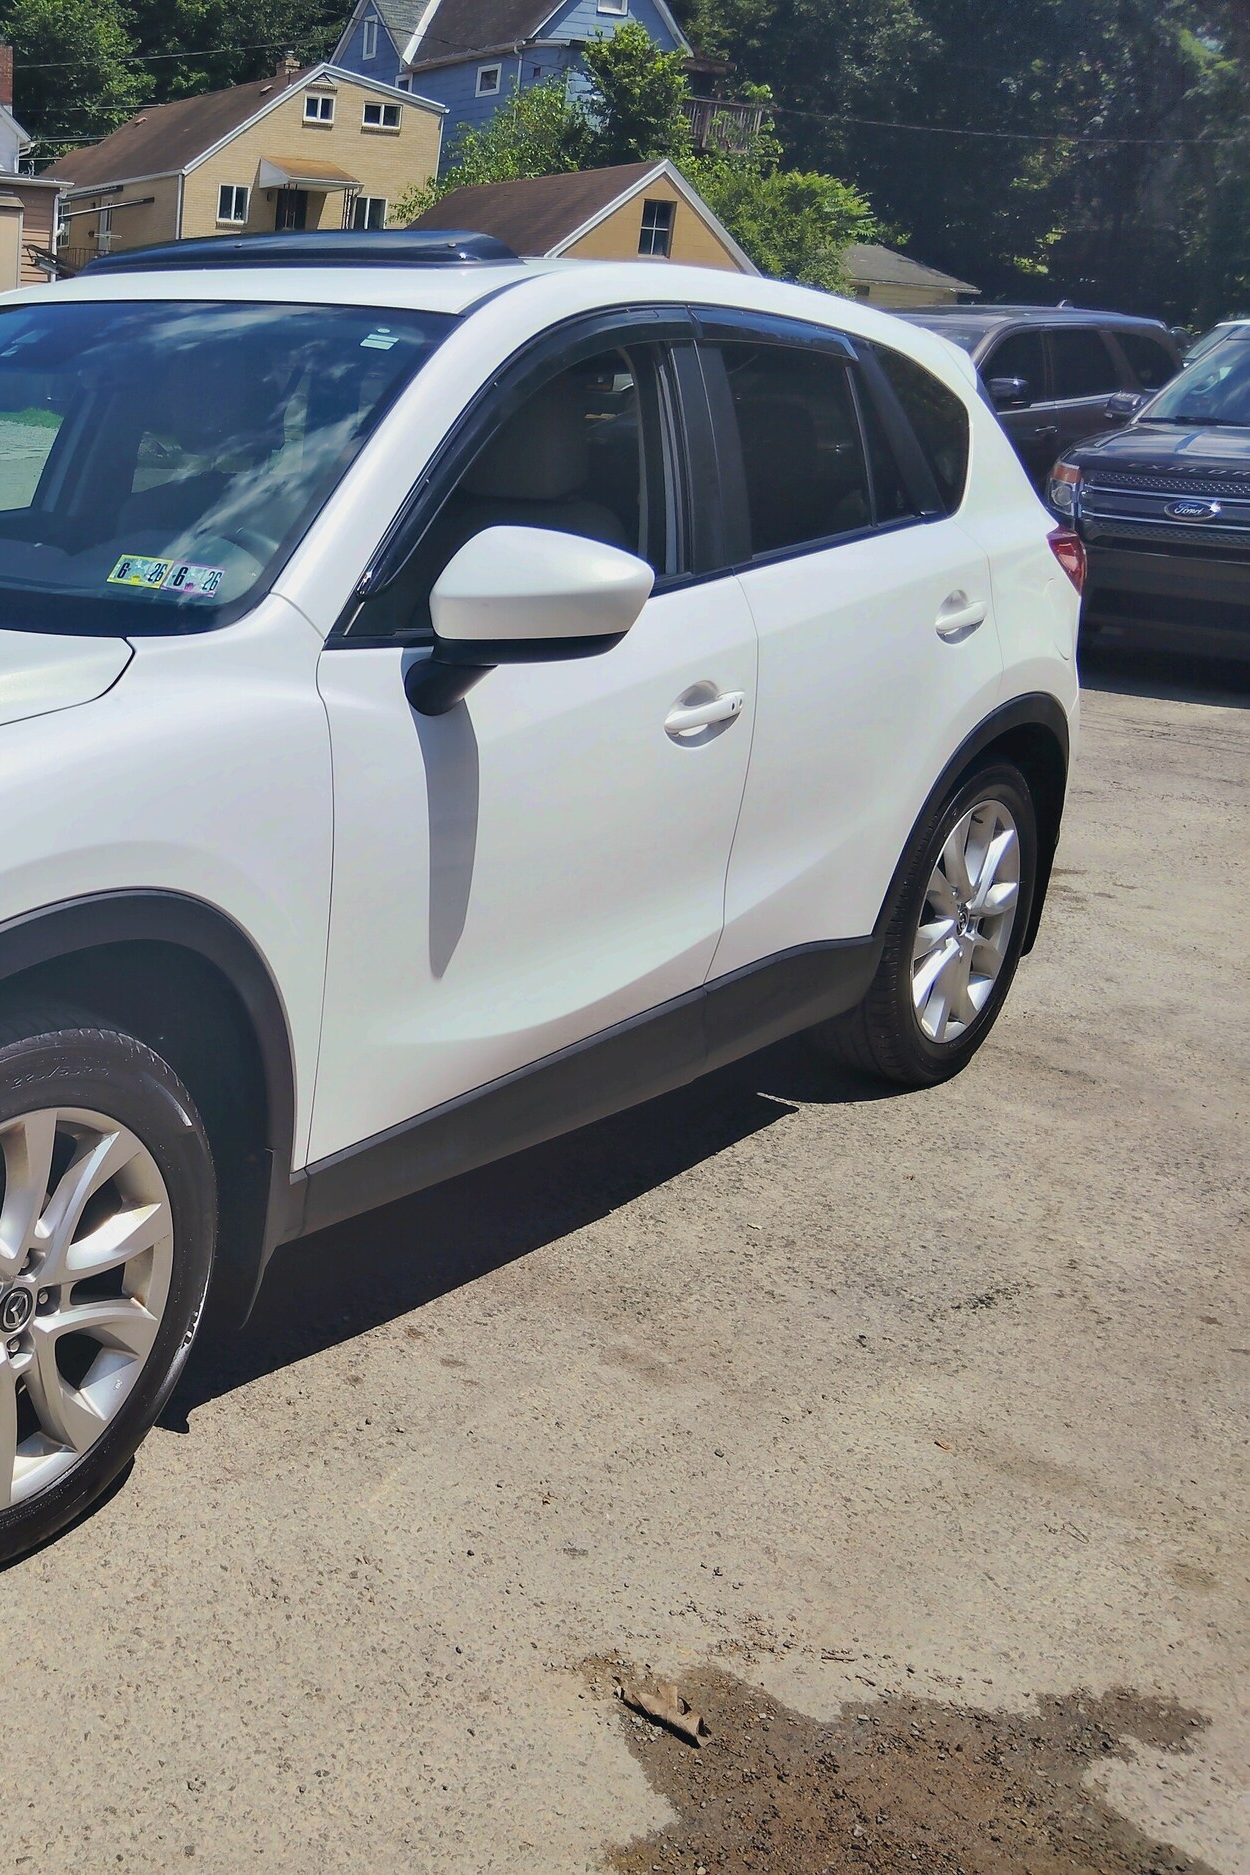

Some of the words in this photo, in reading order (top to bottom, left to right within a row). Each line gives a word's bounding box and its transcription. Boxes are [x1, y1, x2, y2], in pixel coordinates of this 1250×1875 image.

[117, 562, 130, 579] 6
[147, 563, 168, 582] 26
[173, 567, 188, 586] 6
[202, 571, 223, 591] 26
